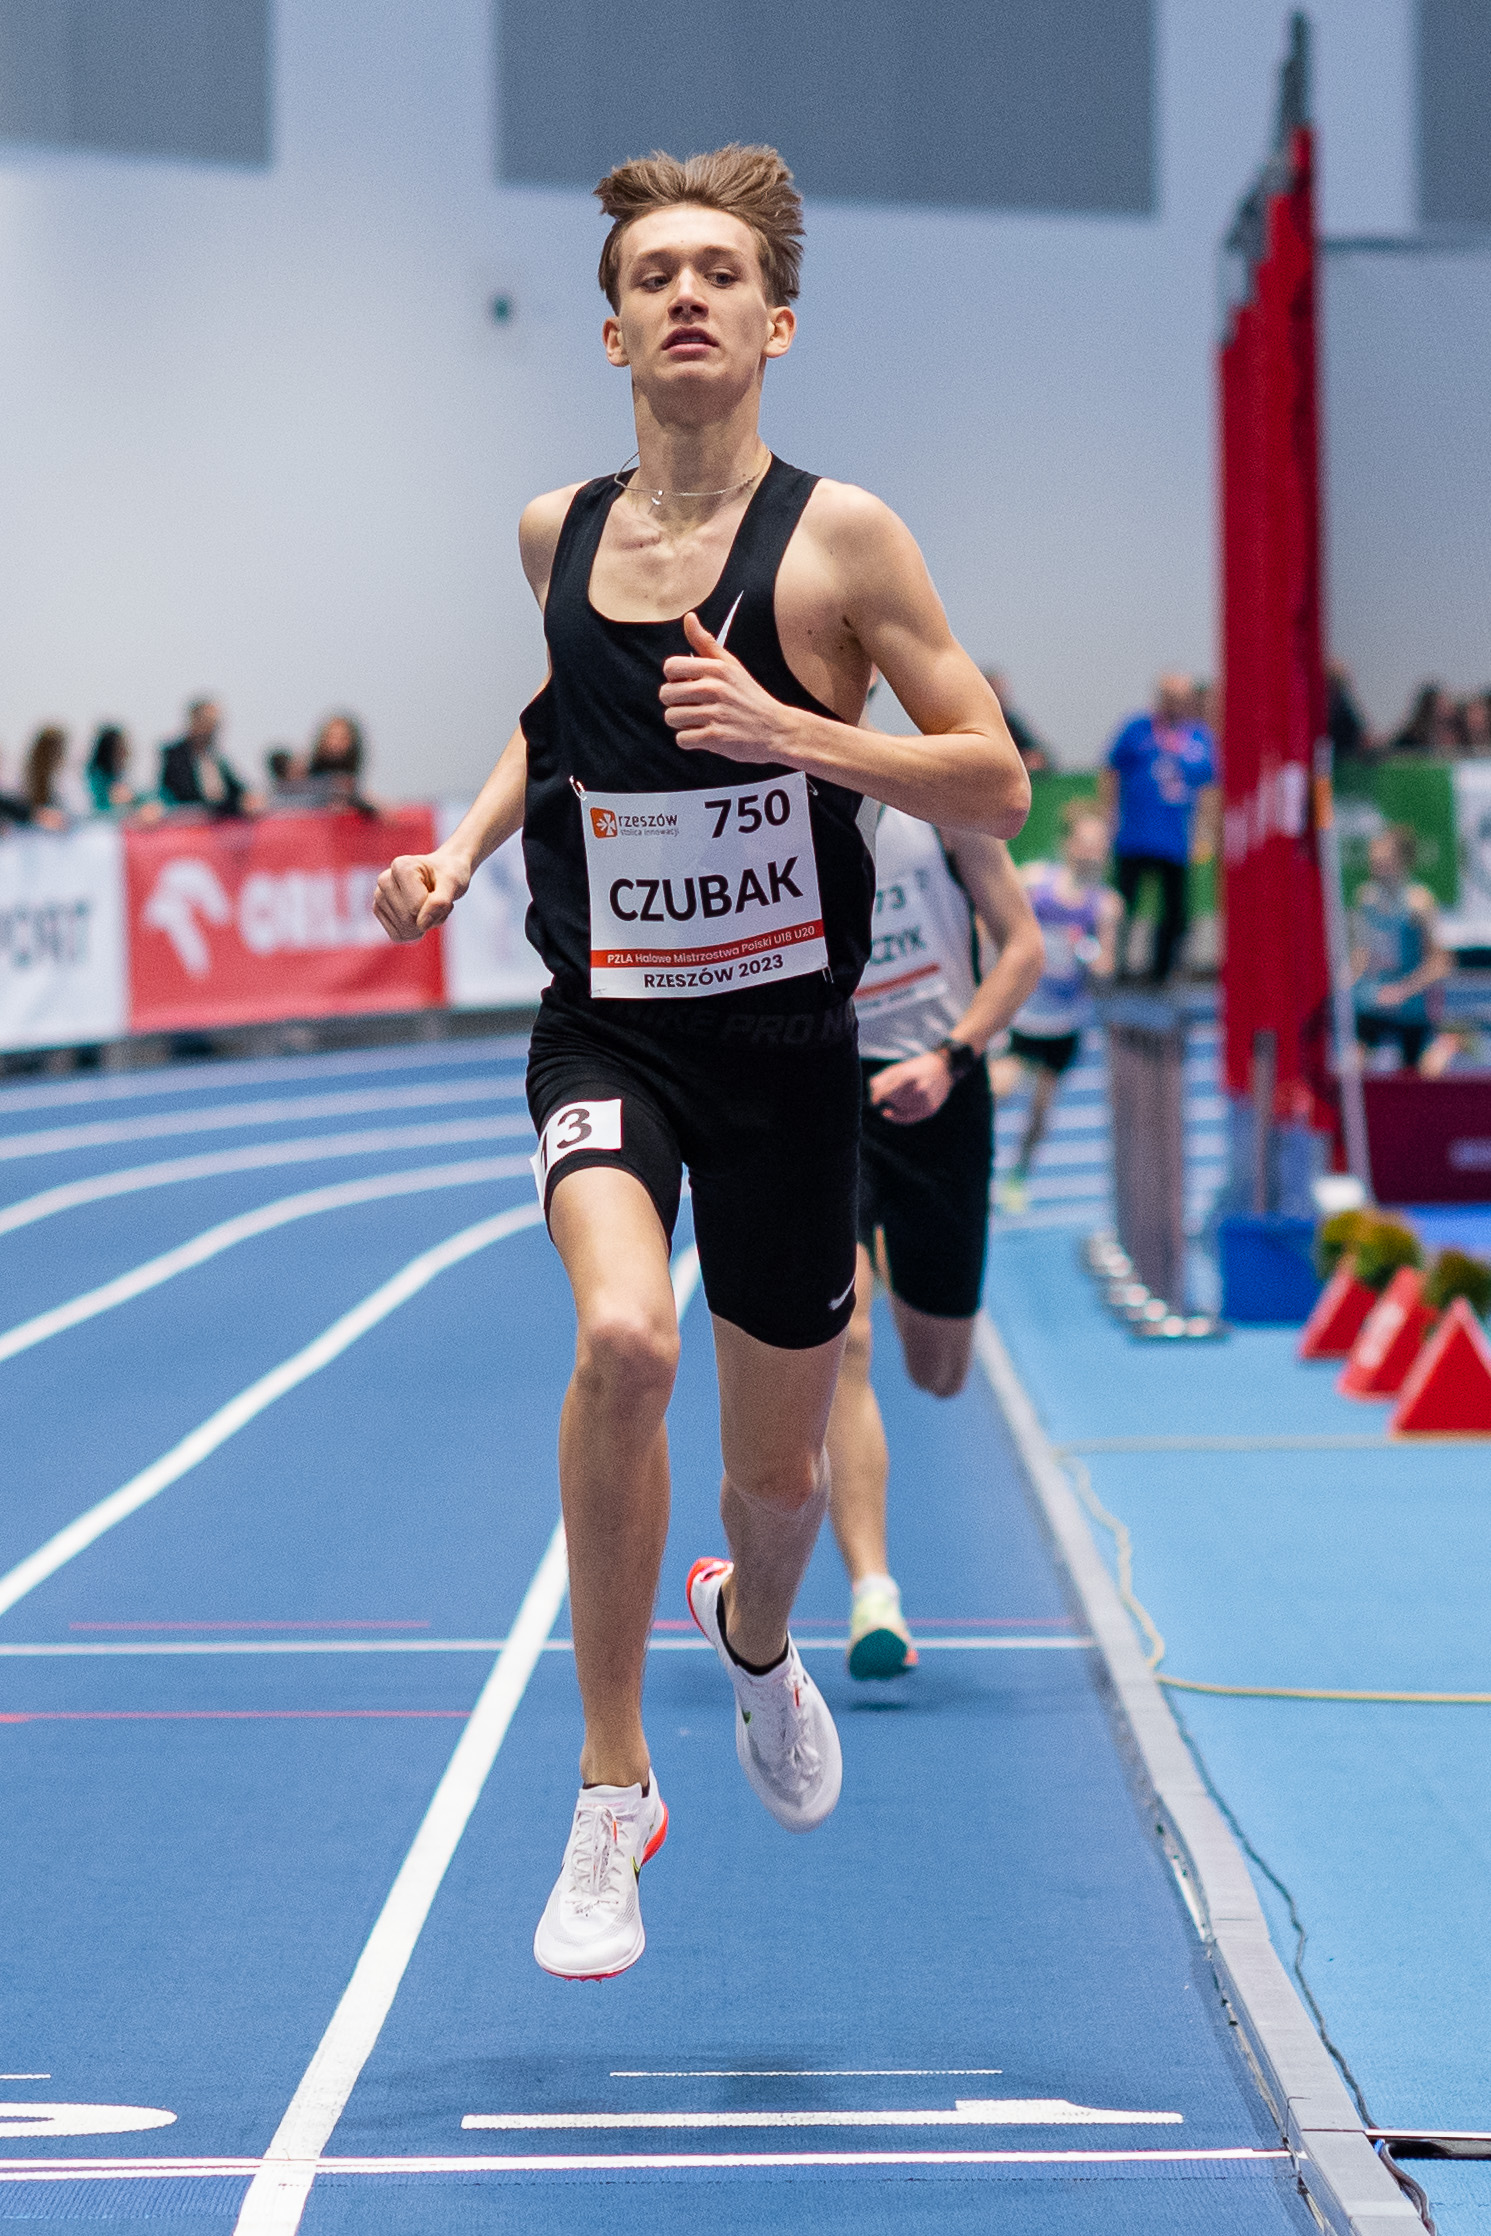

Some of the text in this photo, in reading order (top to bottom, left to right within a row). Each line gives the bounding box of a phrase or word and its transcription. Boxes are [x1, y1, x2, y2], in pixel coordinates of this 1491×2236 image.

[618, 813, 678, 828] rzeszów
[704, 789, 791, 839] 750
[609, 856, 804, 922] CZUBAK
[607, 925, 816, 965] PZLA Halowe Mistrzostwa Polski U18 U20
[643, 954, 784, 989] RZESZÓW 2023
[719, 1013, 815, 1046] PRO
